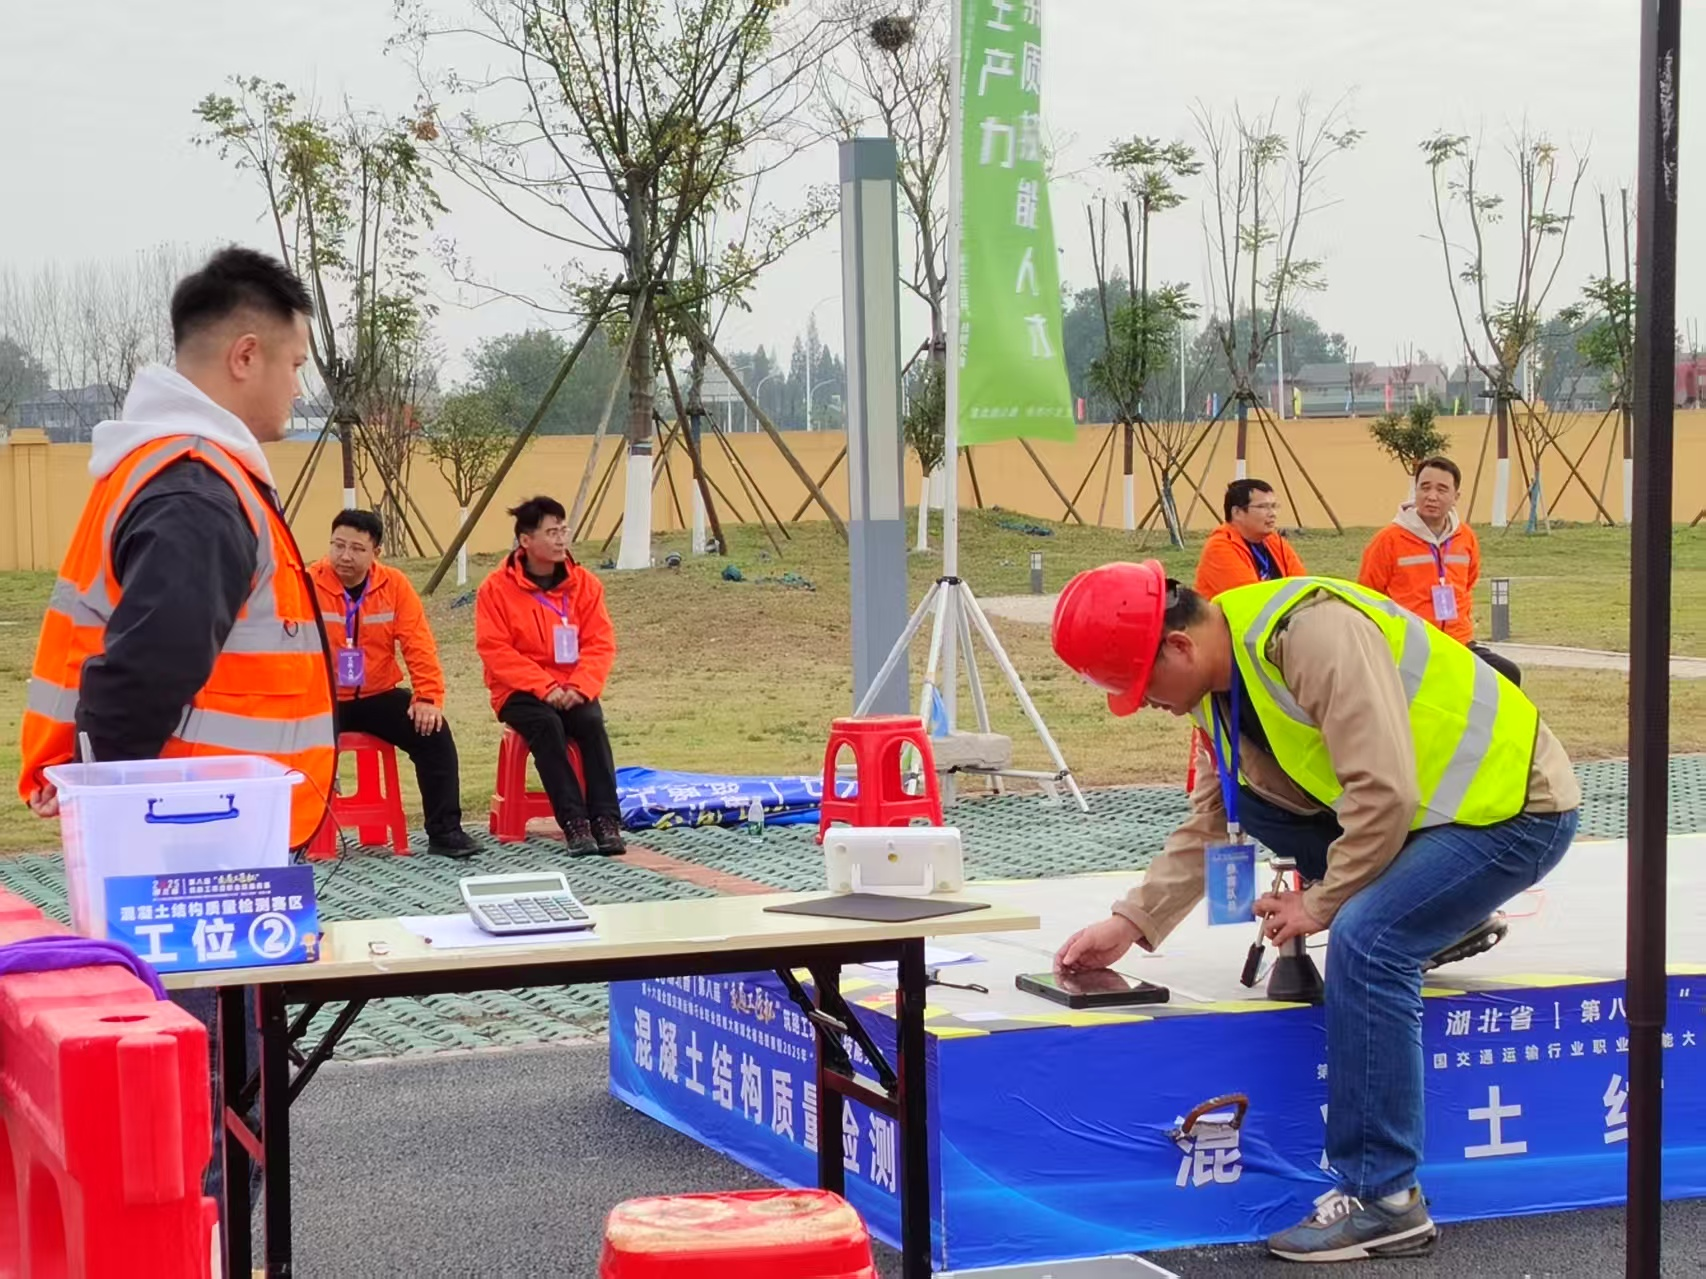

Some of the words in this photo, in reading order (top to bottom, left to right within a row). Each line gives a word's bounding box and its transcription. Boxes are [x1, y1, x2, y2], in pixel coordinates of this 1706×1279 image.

[120, 895, 303, 921] 混凝土结构质量检测赛区
[1445, 1005, 1534, 1037] 湖北省
[1433, 1030, 1697, 1070] 国交通运输行业职业能大
